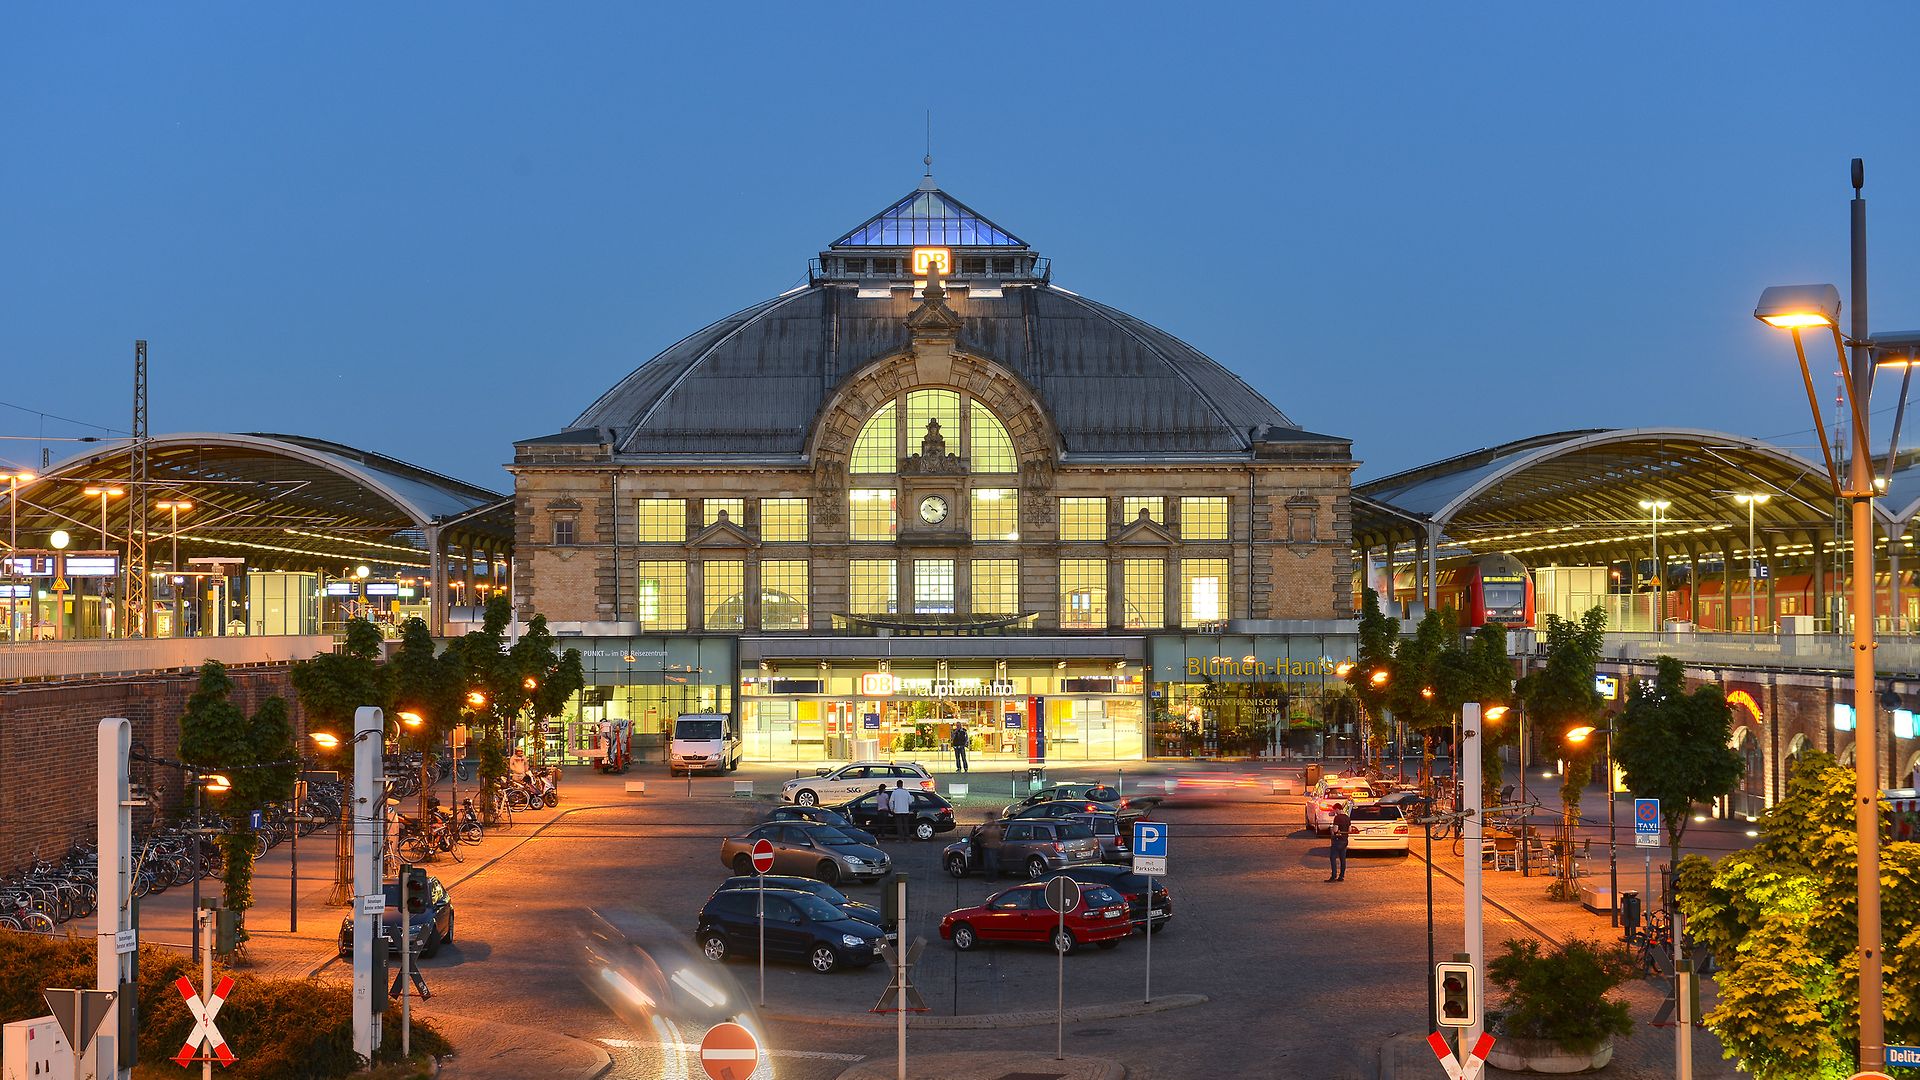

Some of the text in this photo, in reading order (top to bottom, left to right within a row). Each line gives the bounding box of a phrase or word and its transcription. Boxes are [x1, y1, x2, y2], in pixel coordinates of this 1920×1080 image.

[917, 253, 946, 270] DB
[35, 558, 44, 570] F
[1760, 566, 1768, 577] E
[351, 584, 358, 593] E
[1187, 656, 1357, 676] Blumen-Hanisch
[866, 677, 891, 692] DB
[1262, 706, 1279, 714] 1836
[1638, 823, 1657, 831] TAXI
[1141, 826, 1160, 852] P
[1890, 1049, 1920, 1064] Delitz
